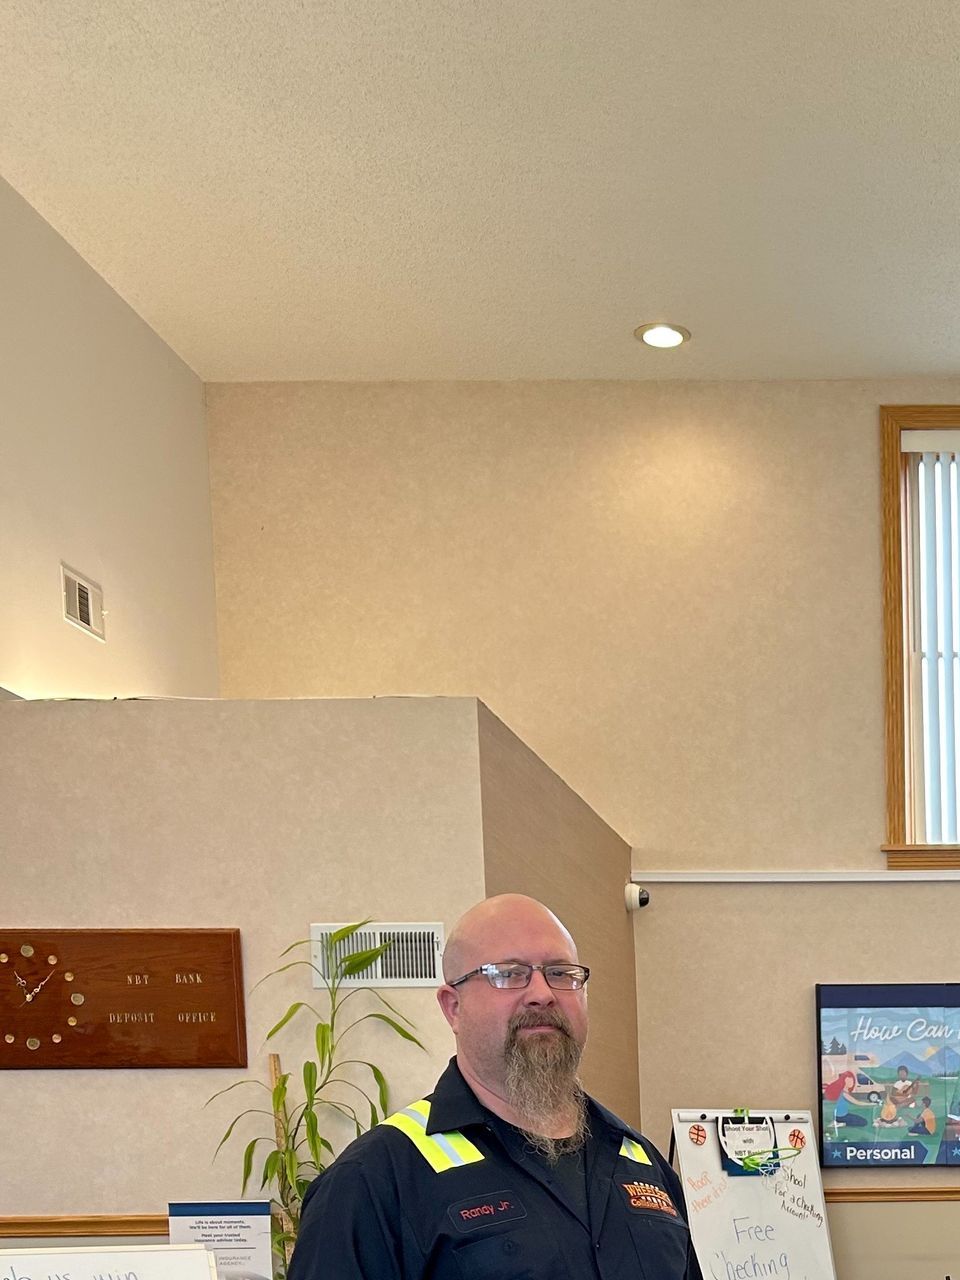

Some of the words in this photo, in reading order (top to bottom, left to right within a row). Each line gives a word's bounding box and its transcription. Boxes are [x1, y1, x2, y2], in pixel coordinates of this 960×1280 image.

[127, 974, 149, 985] NBT
[175, 973, 203, 984] BANK
[109, 1013, 155, 1023] DEPOSIT
[178, 1012, 216, 1023] OFFICE
[851, 1016, 902, 1041] How
[906, 1018, 954, 1041] Can
[845, 1146, 916, 1161] Personal
[460, 1205, 495, 1220] Randy
[733, 1216, 776, 1244] Free
